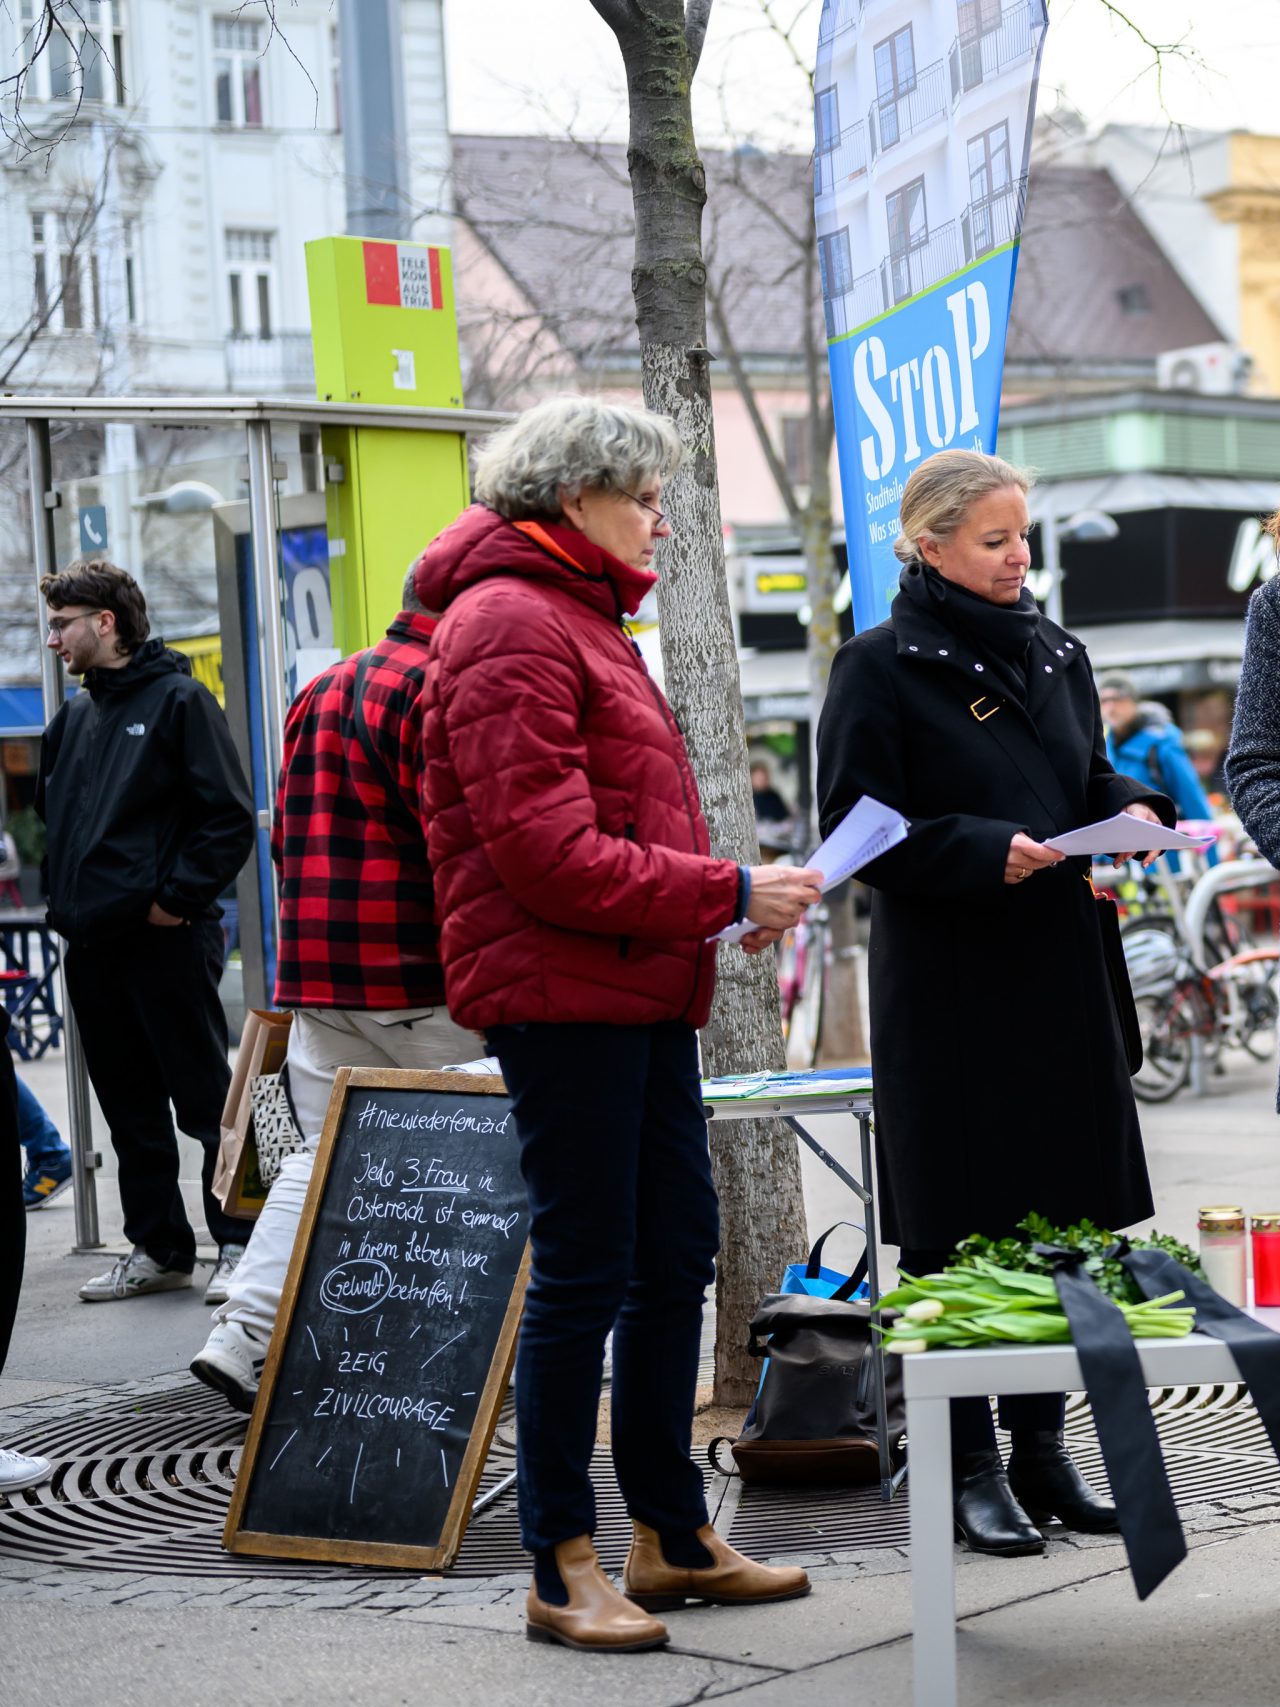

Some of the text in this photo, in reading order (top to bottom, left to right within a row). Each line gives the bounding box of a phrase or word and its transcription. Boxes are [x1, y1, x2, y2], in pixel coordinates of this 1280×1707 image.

[400, 256, 427, 270] TELE
[401, 270, 428, 282] KOM
[402, 283, 429, 296] AUS
[404, 295, 430, 308] TRIA
[866, 476, 903, 515] Stadtteile
[869, 521, 887, 545] Was
[358, 1100, 512, 1135] #niewiederfemizid
[353, 1152, 394, 1188] Jede
[425, 1158, 468, 1188] Frau
[478, 1169, 494, 1192] in
[347, 1187, 519, 1239] Österreich ist einmal
[338, 1230, 489, 1276] in ihrem Leben von
[327, 1270, 385, 1300] Gewalt
